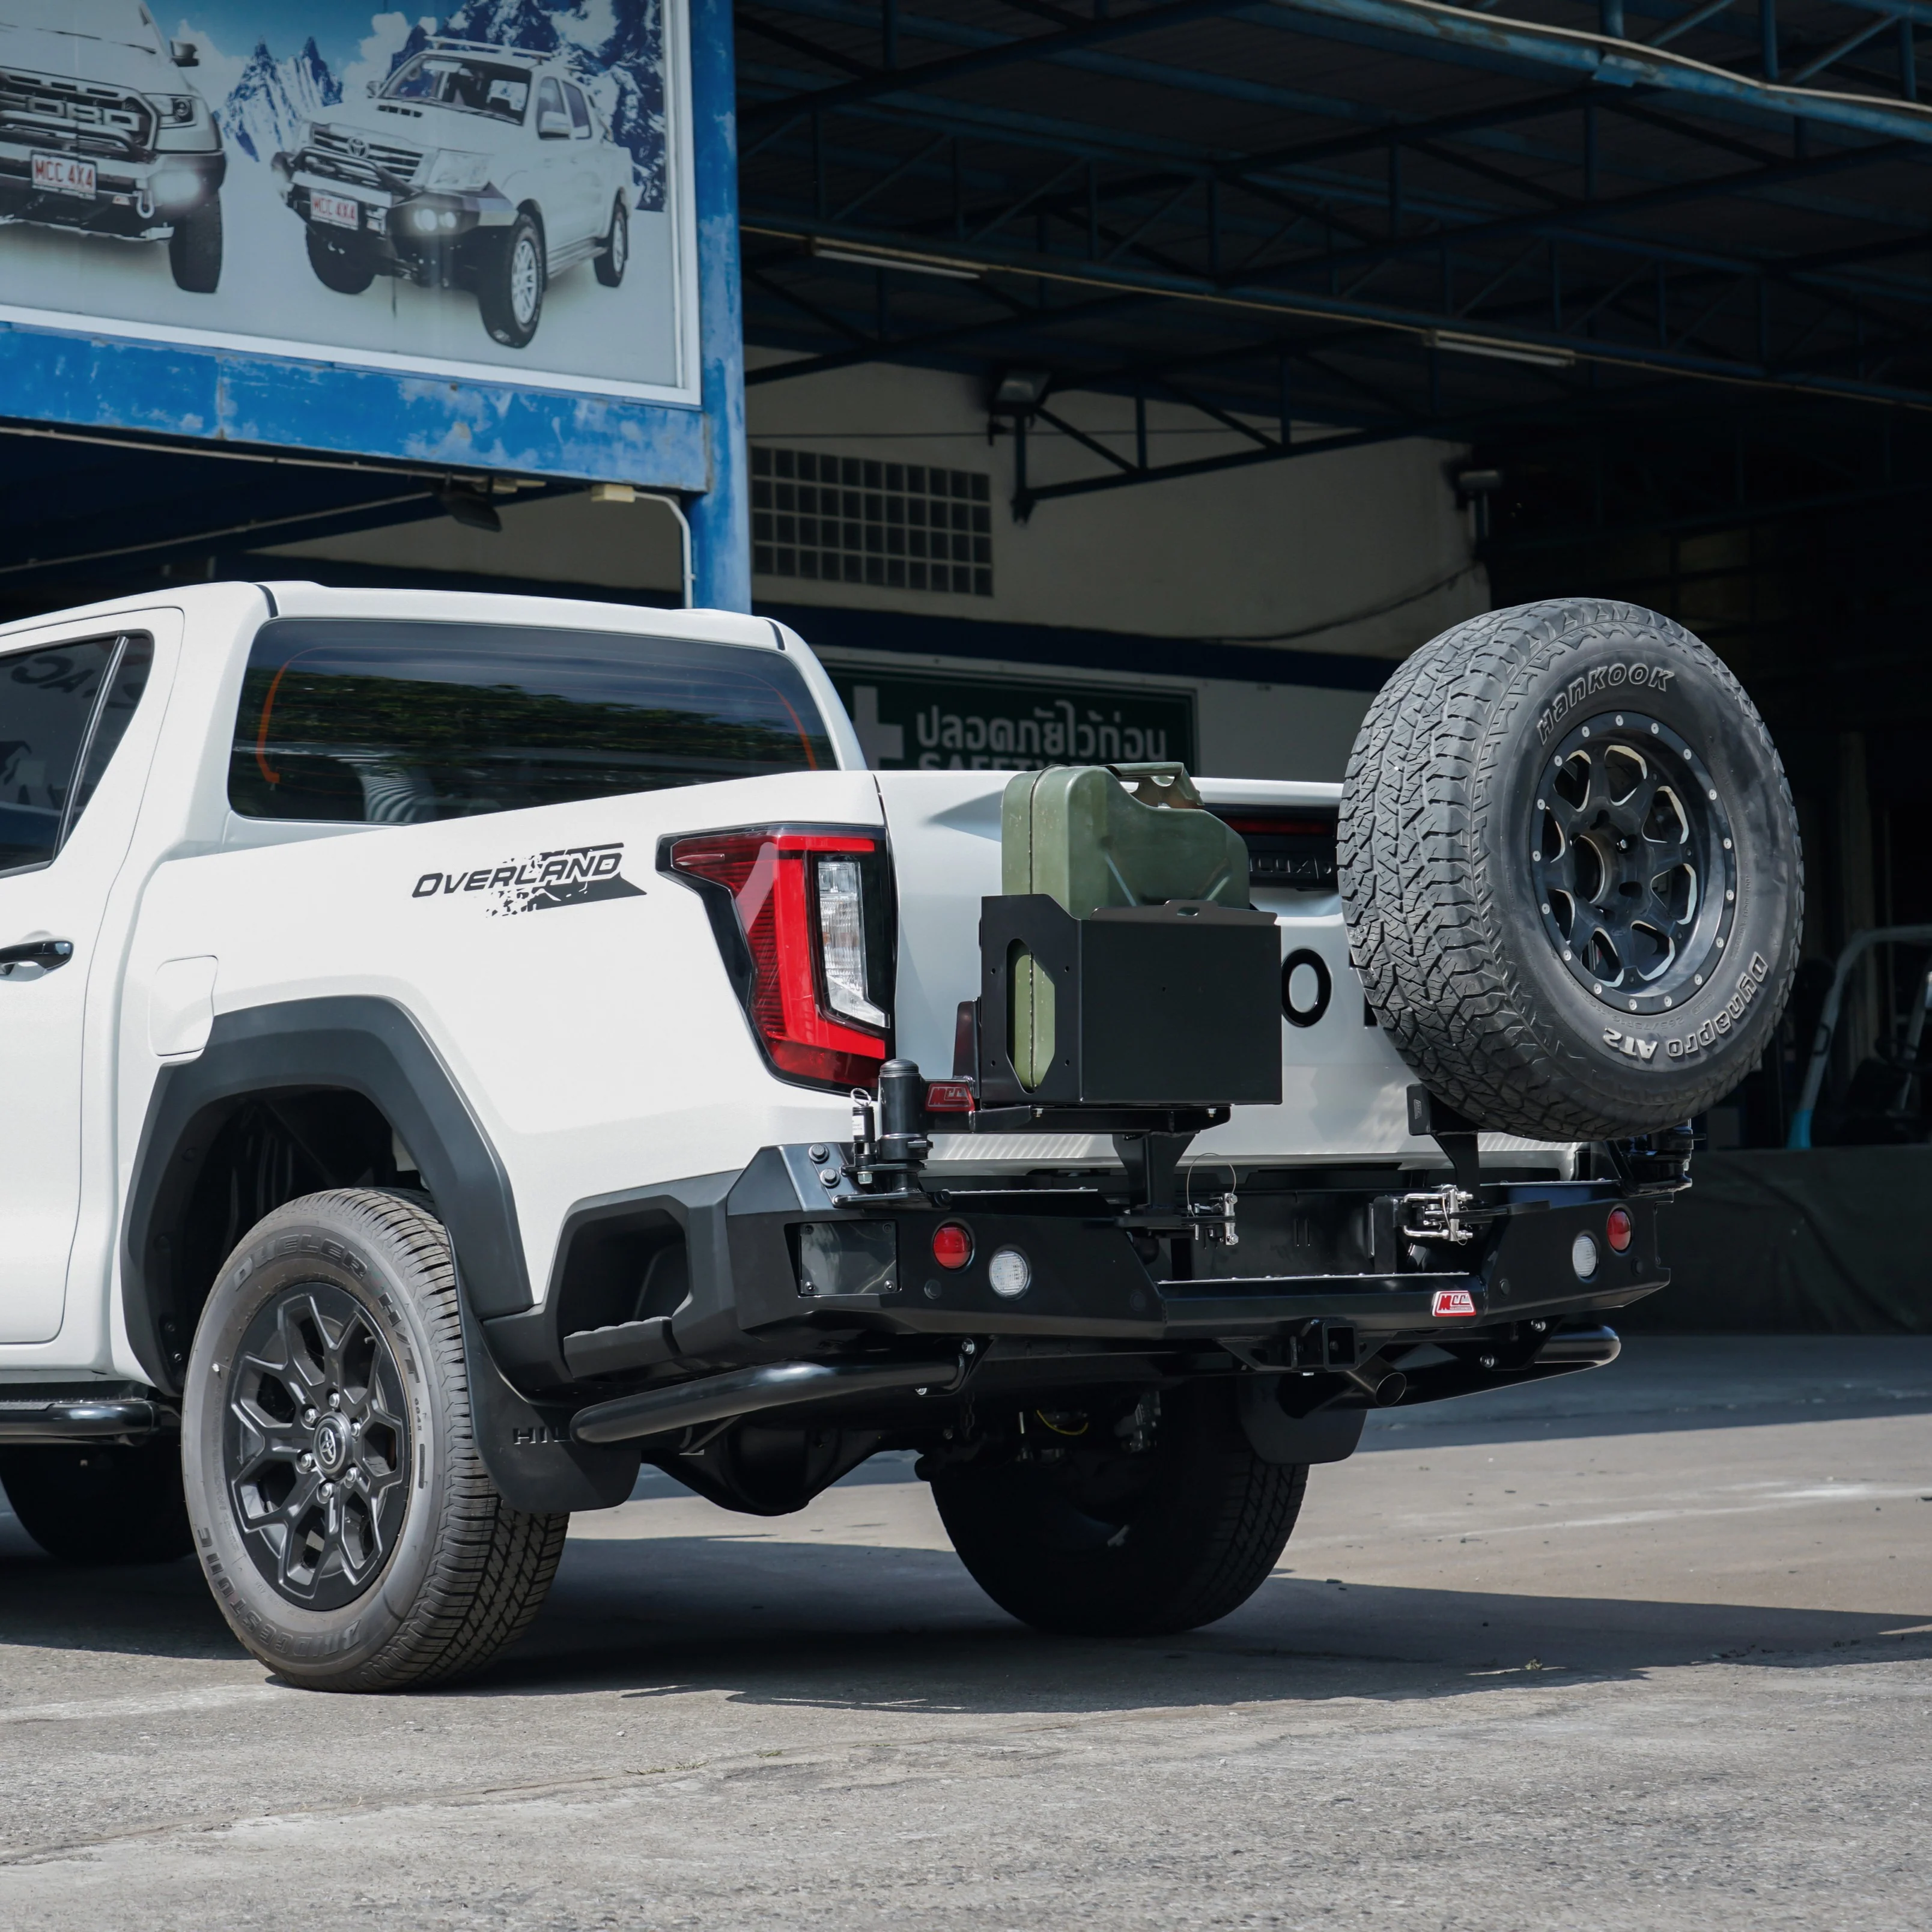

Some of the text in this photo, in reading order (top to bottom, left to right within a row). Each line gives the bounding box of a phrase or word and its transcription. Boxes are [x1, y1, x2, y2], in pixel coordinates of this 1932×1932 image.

[34, 159, 64, 182] MCC
[916, 699, 1167, 763] ปลอดภัยไว้ก่อน
[412, 852, 622, 898] OVERLAND
[1602, 951, 1768, 1059] Dynapro AT2
[234, 1234, 368, 1291] DUELER
[378, 1292, 421, 1384] H/T
[195, 1526, 361, 1657] BRIDGESTONE
